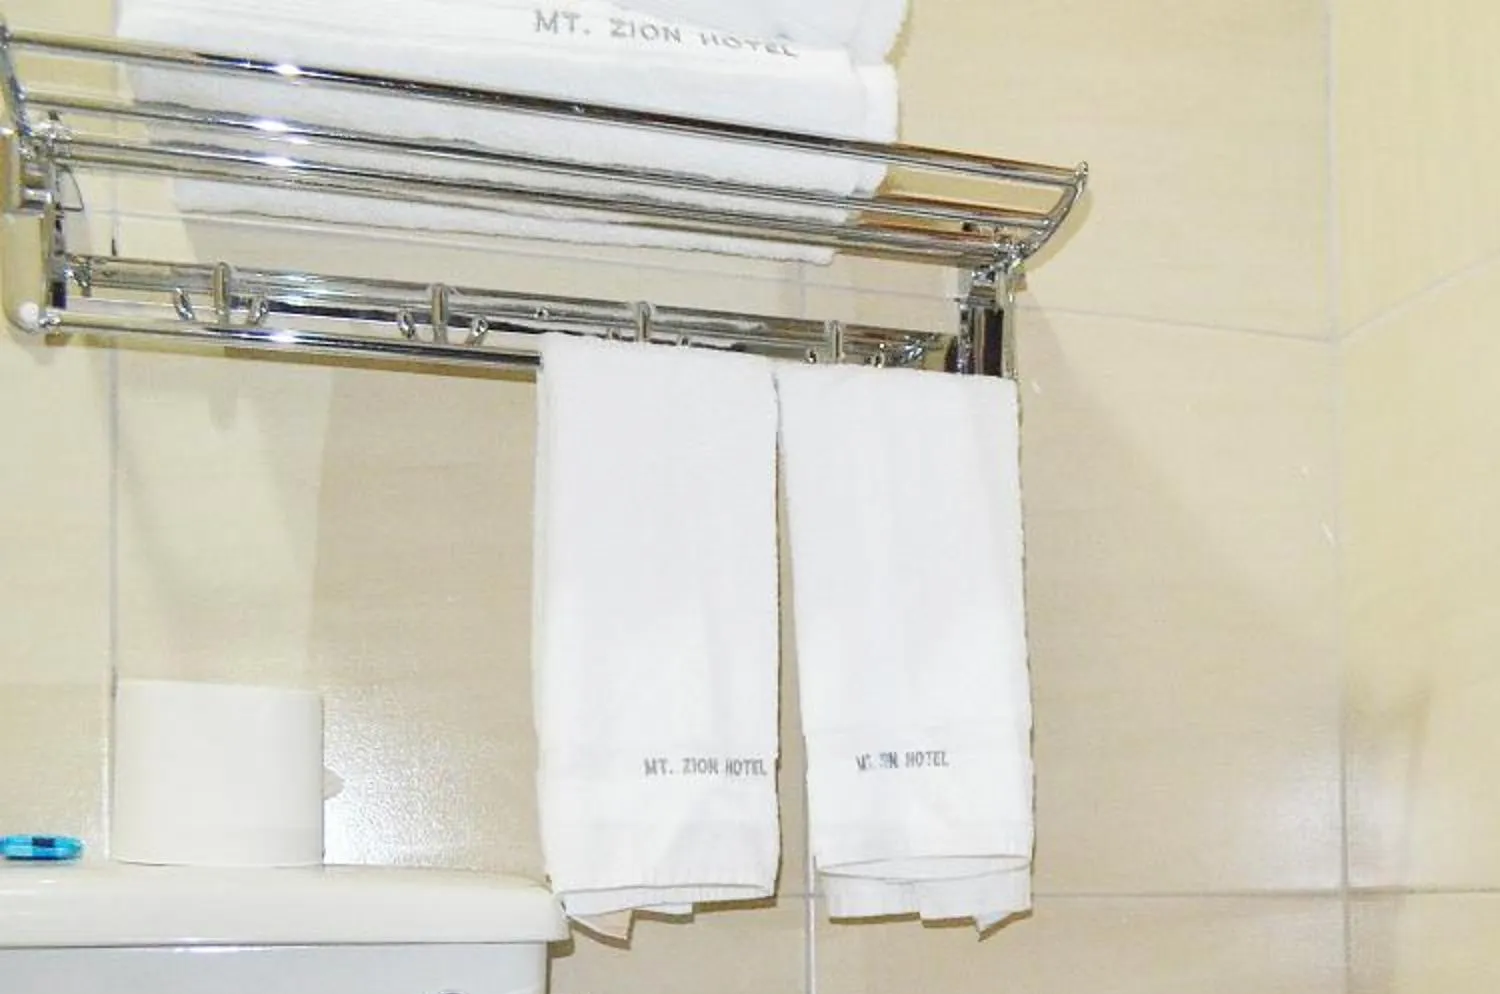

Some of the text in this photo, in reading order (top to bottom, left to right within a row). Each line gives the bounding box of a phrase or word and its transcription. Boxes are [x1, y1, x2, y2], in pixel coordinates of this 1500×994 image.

[534, 9, 799, 58] MT. ZION HOTEL
[643, 757, 768, 776] MT. ZION HOTEL
[904, 750, 950, 768] HOTEL
